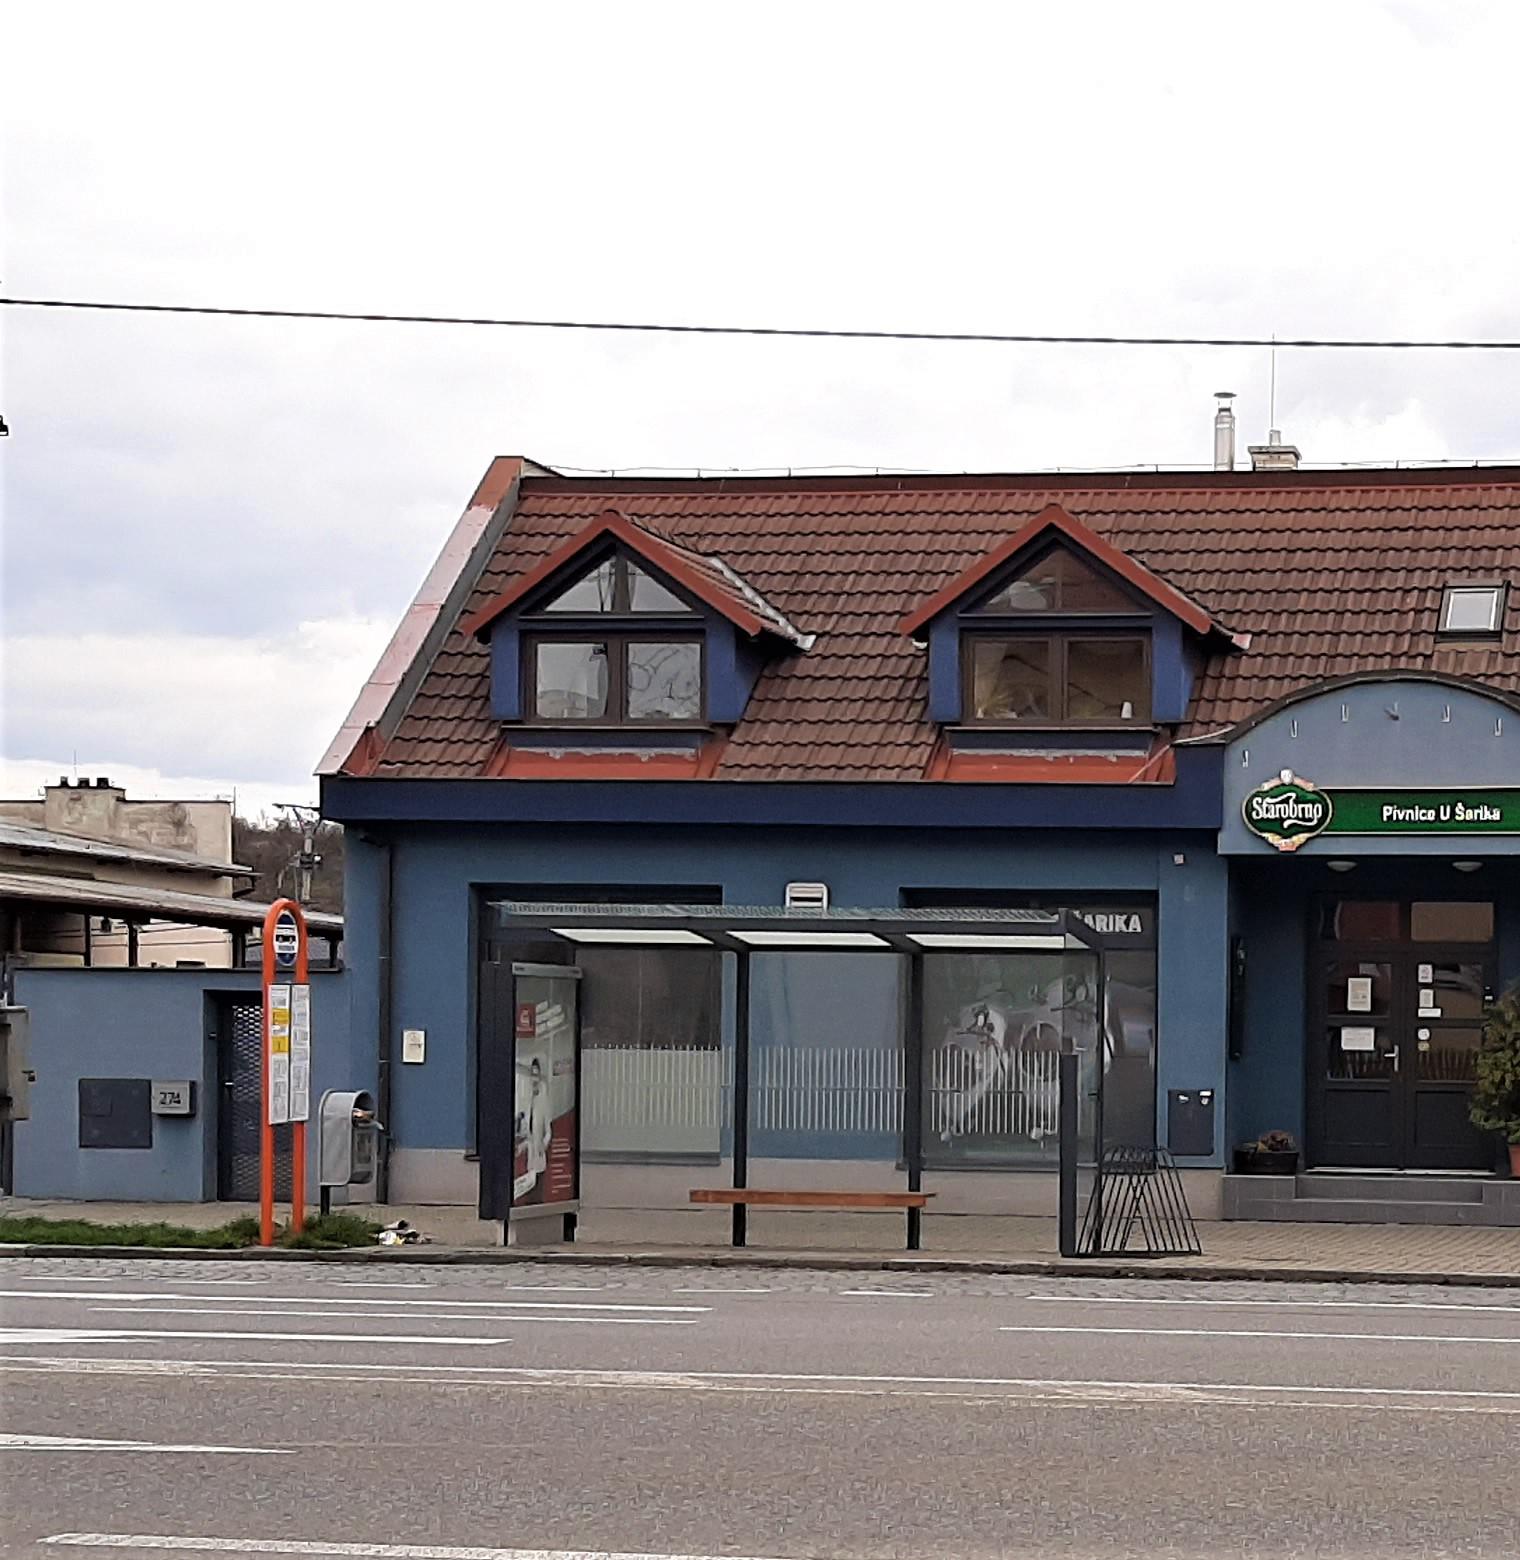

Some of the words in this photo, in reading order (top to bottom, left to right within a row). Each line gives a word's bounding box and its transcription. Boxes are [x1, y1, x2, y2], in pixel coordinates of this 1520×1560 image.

[1252, 793, 1322, 829] Starobrno
[1382, 805, 1436, 821] Pivnice
[1439, 805, 1450, 821] U
[1455, 802, 1501, 821] Šarika
[1073, 910, 1142, 933] ARIKA
